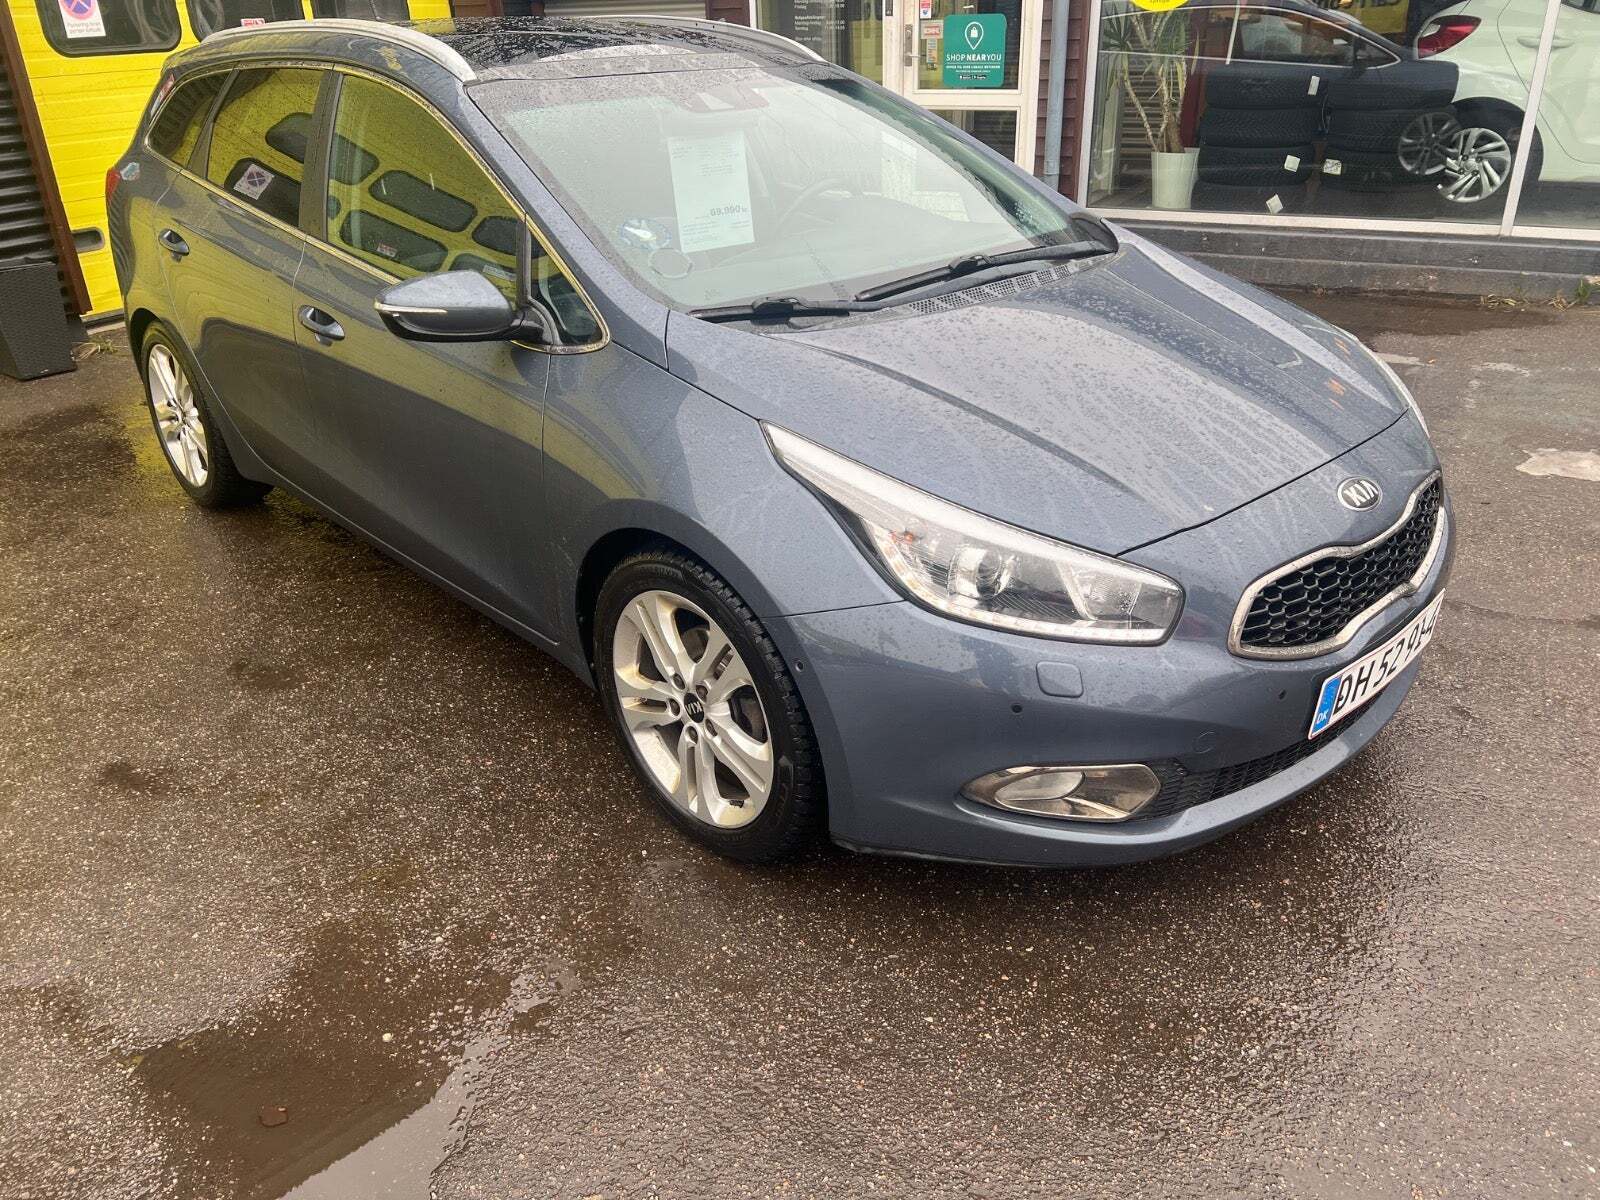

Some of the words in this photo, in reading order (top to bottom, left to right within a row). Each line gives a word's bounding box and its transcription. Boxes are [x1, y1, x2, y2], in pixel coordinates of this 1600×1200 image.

[1343, 480, 1379, 507] KIA
[1332, 659, 1377, 716] DH
[1372, 637, 1406, 688] 52
[685, 701, 703, 715] KIA
[1317, 709, 1329, 725] DK
